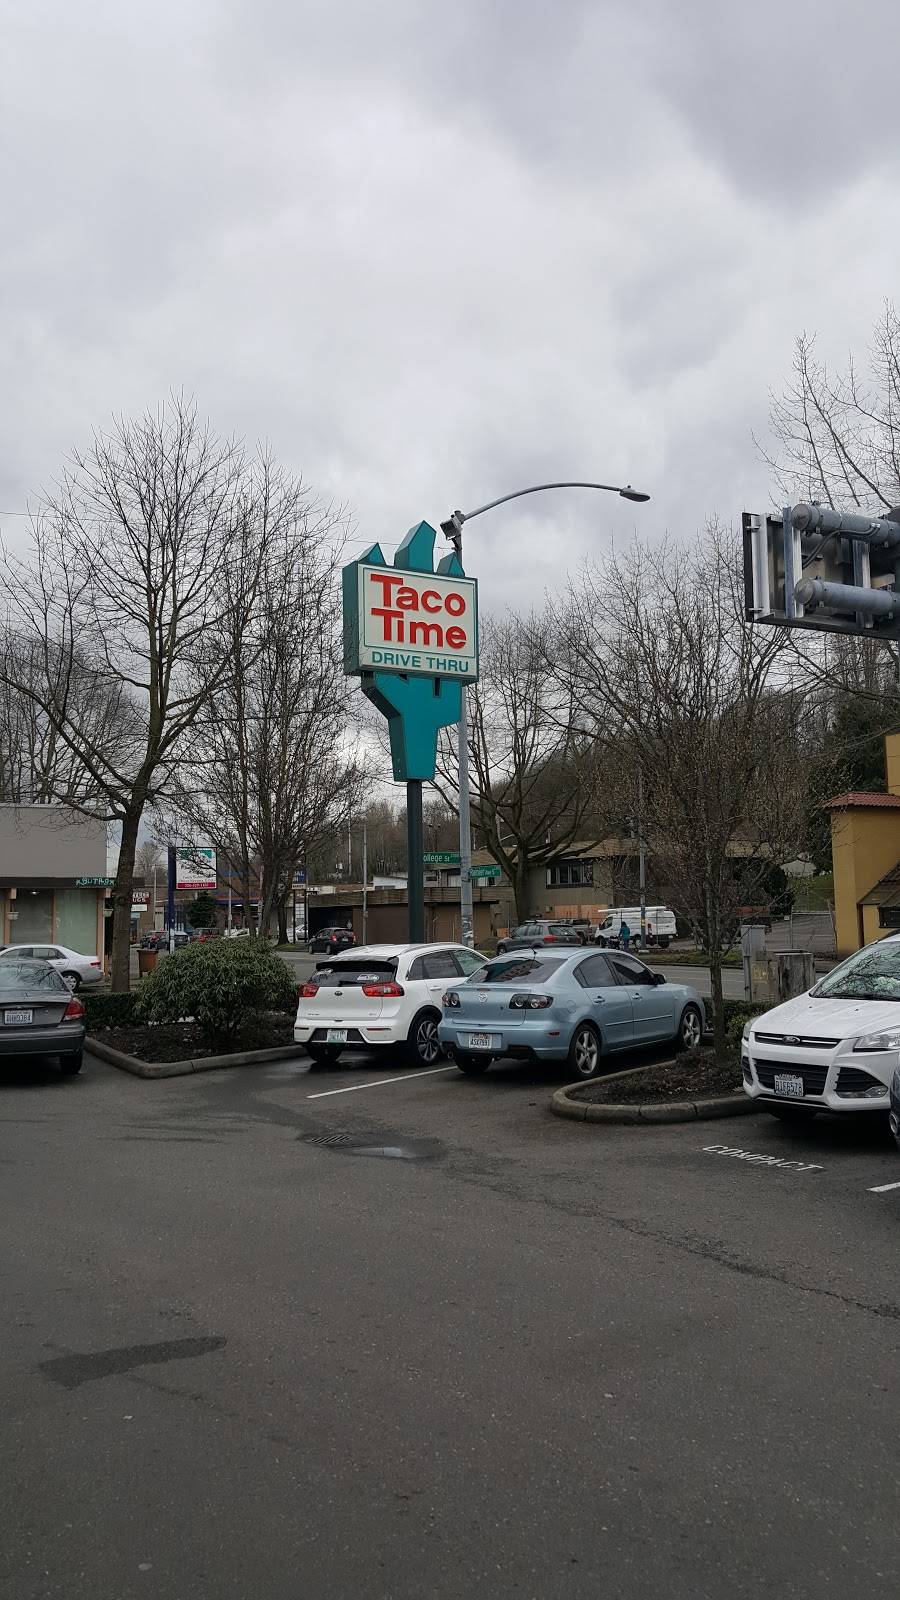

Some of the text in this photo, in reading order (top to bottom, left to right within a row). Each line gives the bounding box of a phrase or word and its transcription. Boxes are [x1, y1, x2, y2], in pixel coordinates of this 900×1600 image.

[370, 574, 466, 617] Taco
[370, 608, 467, 649] Time
[371, 651, 469, 672] DRIVE THRU
[423, 854, 443, 863] ollege
[702, 1145, 824, 1171] COMPACT
